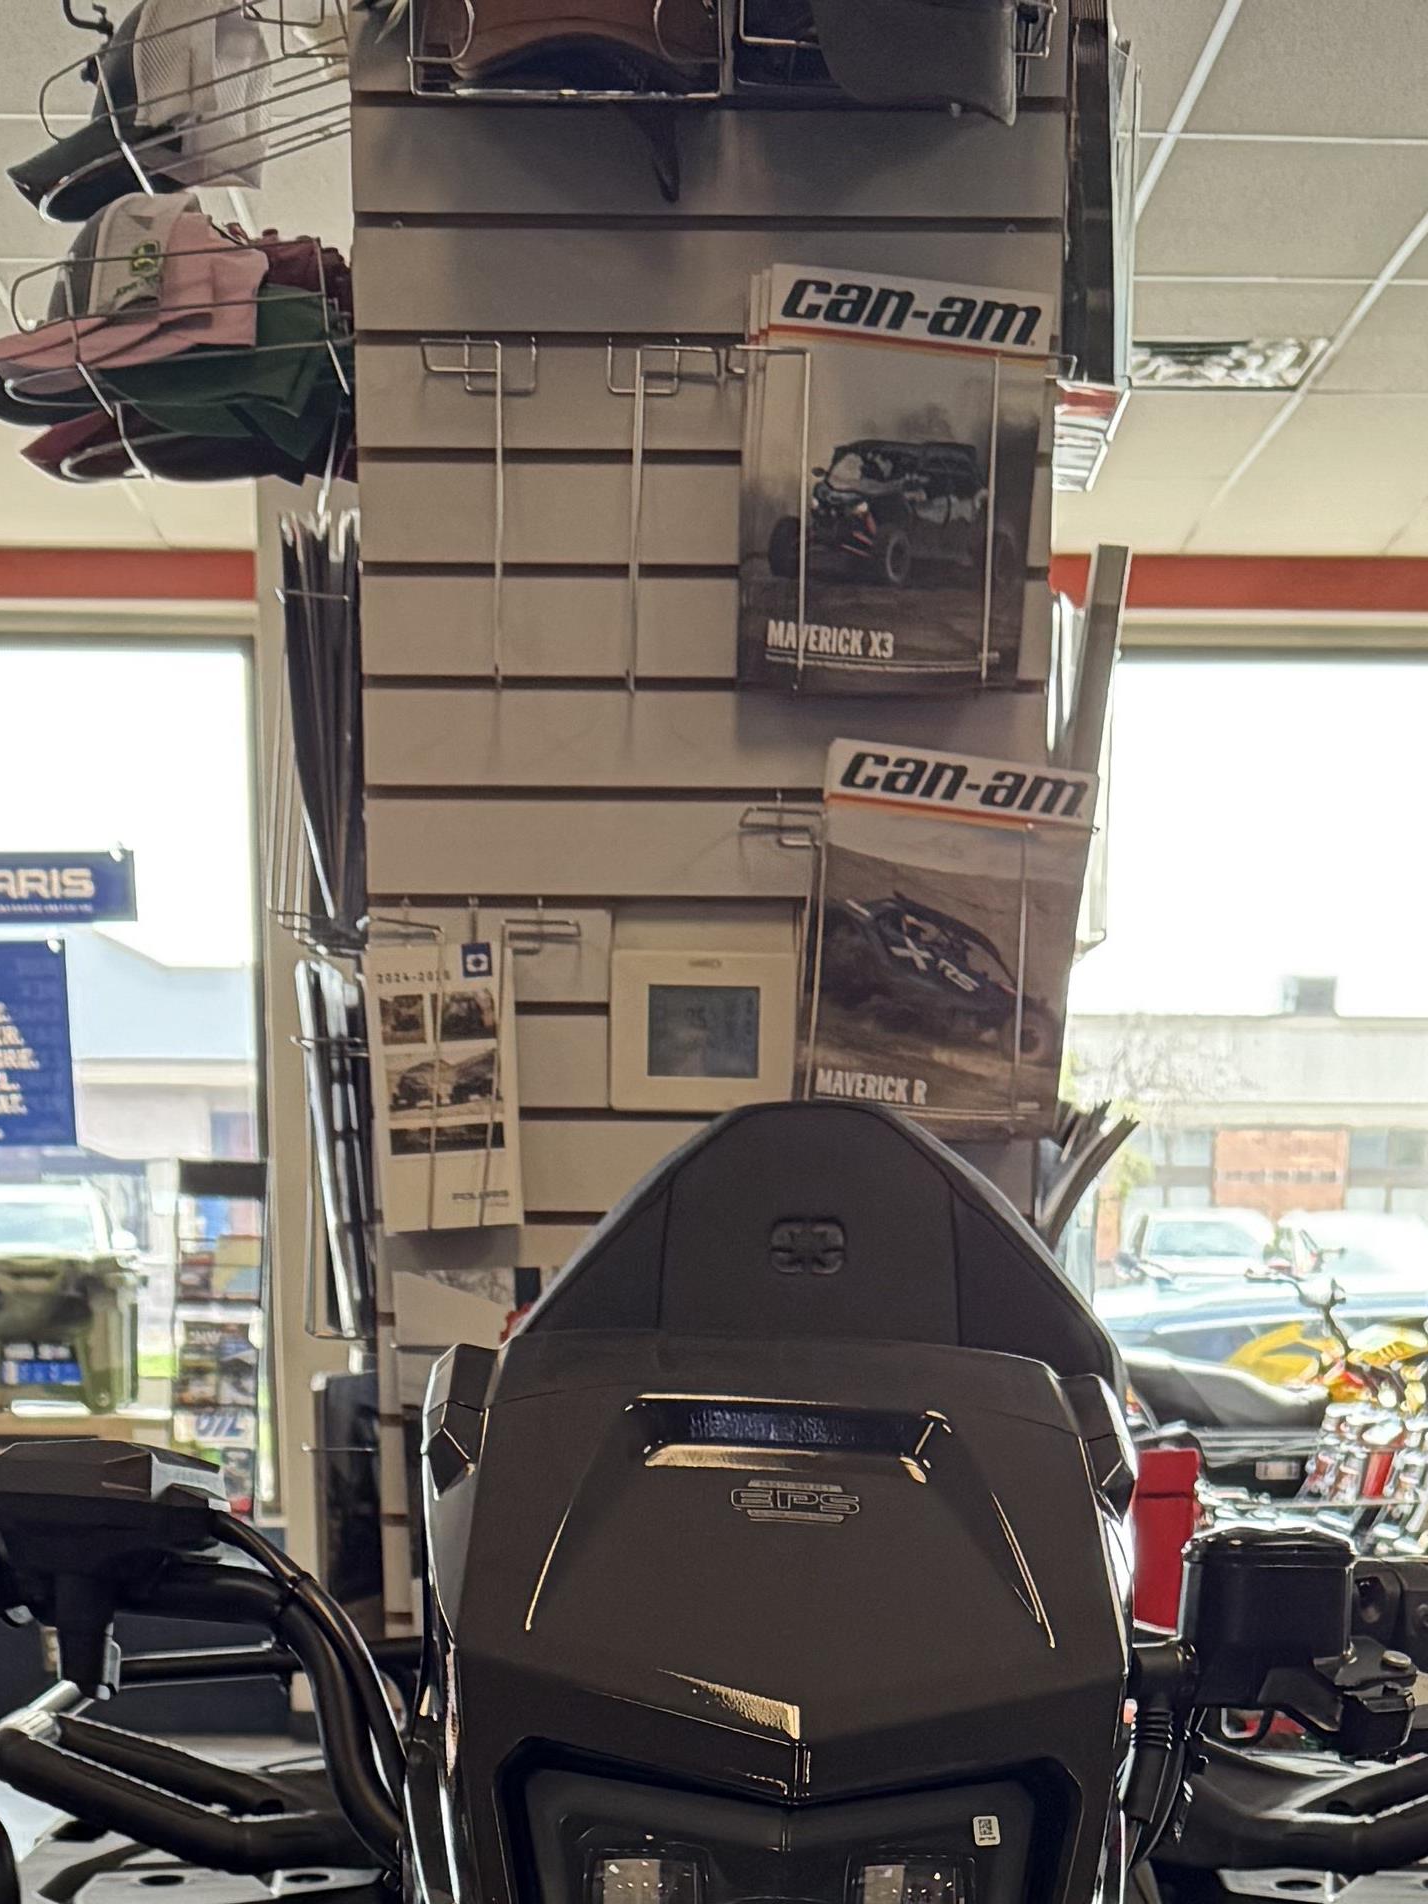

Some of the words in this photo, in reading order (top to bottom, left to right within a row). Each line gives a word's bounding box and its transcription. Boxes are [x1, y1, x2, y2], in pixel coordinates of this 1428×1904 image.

[781, 279, 1042, 345] can-am
[765, 619, 864, 656] MAVERICK
[868, 630, 895, 659] X3
[840, 752, 1089, 817] can-am
[814, 1067, 910, 1104] MAVERICK
[912, 1079, 929, 1105] R
[730, 1487, 861, 1515] EPS
